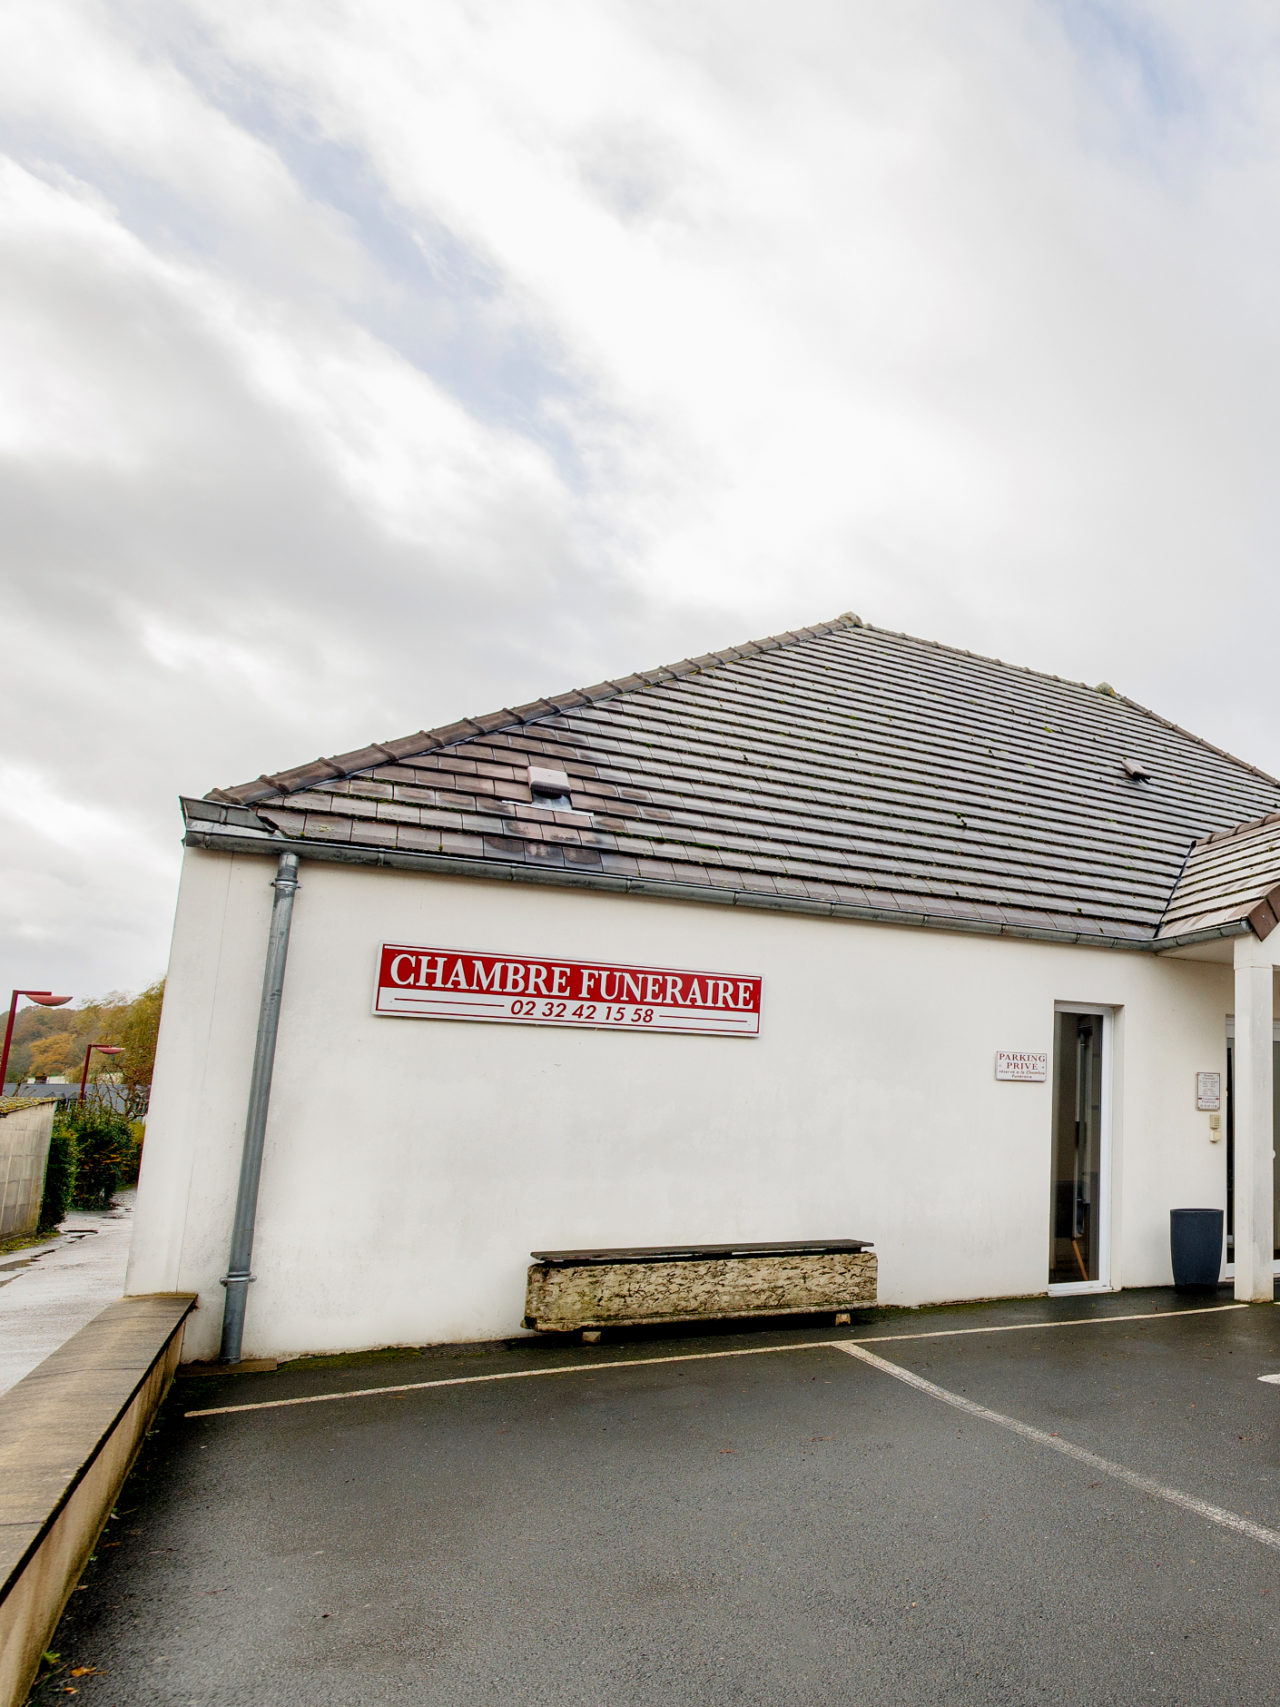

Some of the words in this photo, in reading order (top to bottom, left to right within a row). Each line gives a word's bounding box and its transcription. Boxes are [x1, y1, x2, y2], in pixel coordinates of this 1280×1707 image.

[390, 953, 571, 997] CHAMBRE
[578, 968, 754, 1010] FUNERAIRE
[511, 1000, 536, 1016] 02
[542, 1002, 567, 1018] 32
[572, 1004, 597, 1020] 42
[605, 1006, 626, 1021] 15
[631, 1008, 654, 1023] 58
[1000, 1053, 1045, 1062] PARKING
[1007, 1062, 1037, 1070] PRIVÉ
